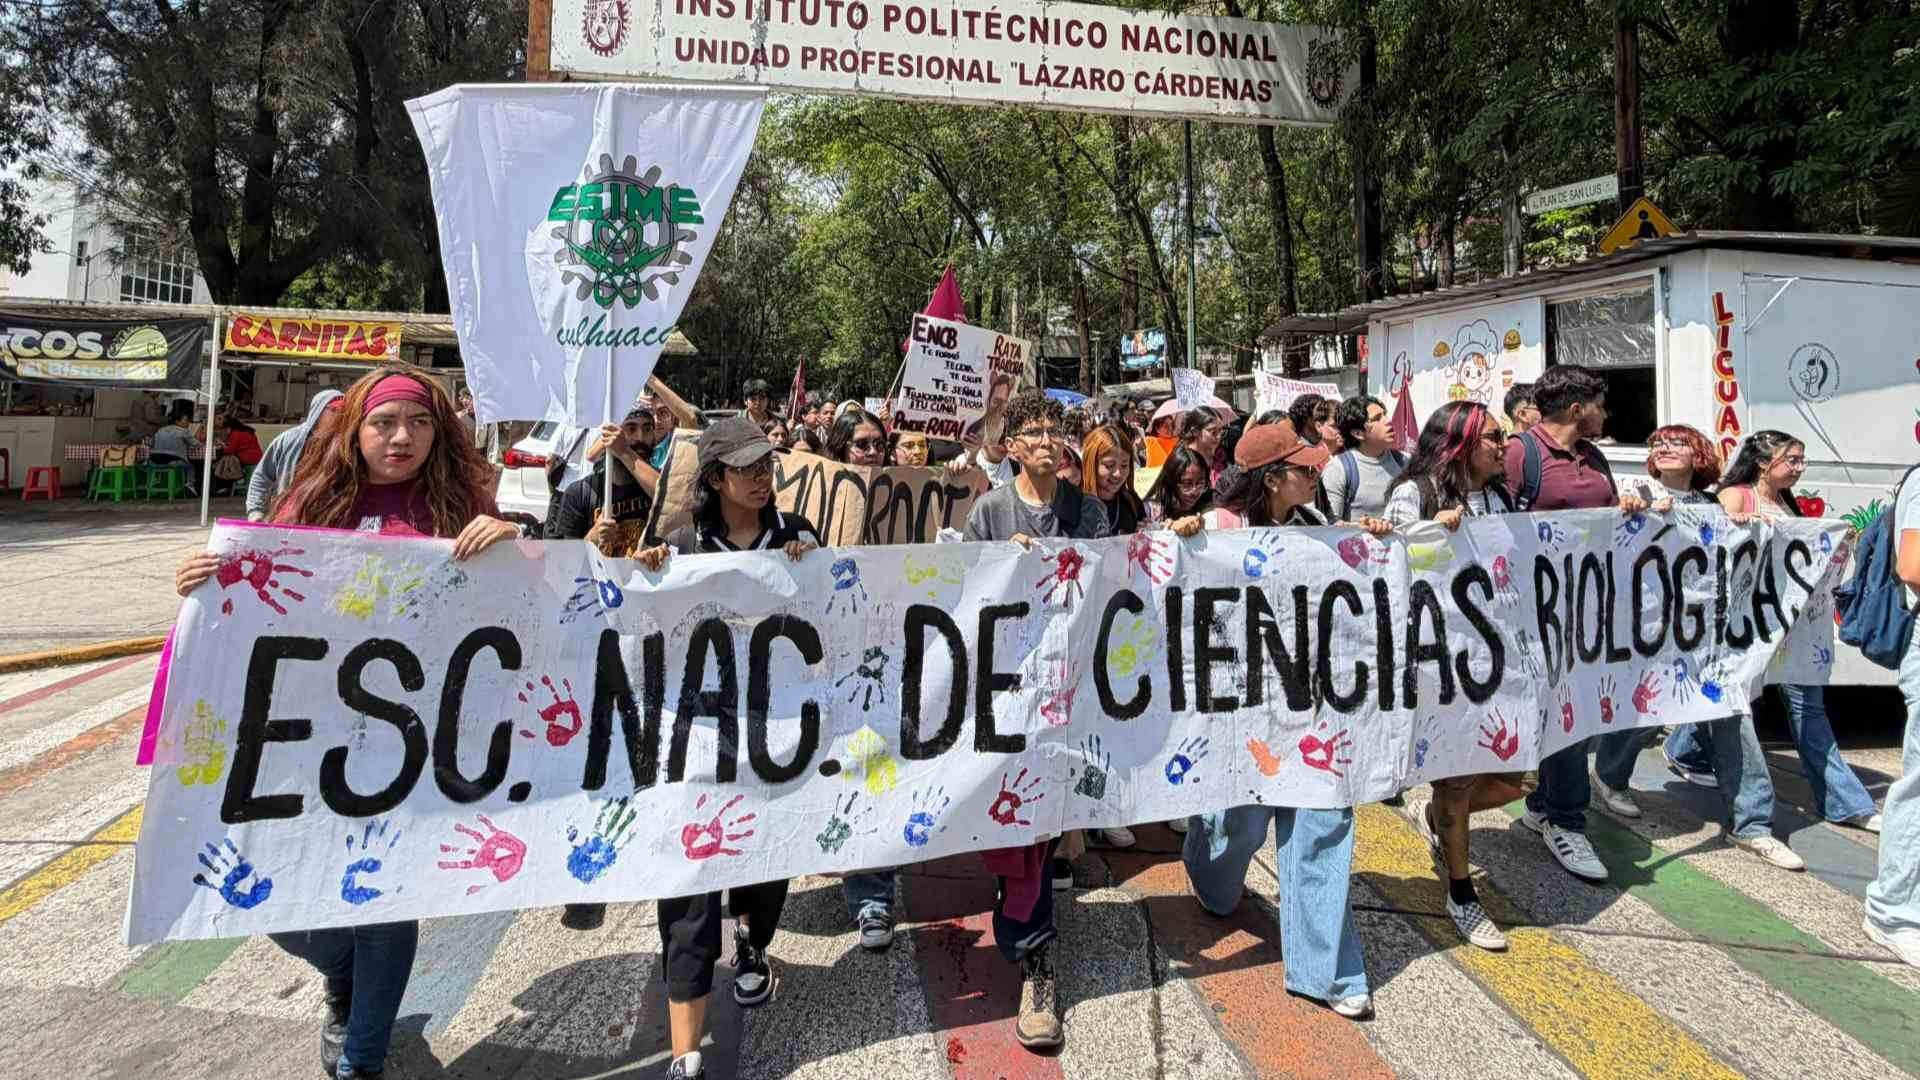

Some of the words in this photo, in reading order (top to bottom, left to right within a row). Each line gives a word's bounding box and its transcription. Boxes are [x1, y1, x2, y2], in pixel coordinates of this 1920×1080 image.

[675, 0, 868, 31] INSTITUTO
[883, 3, 1107, 49] POLITÉCNICO
[1121, 24, 1277, 62] NACIONAL
[675, 37, 789, 68] UNIDAD
[801, 46, 1001, 83] PROFESIONAL
[1011, 54, 1124, 93] "LÁZARO
[1134, 66, 1279, 103] CÁRDENAS"
[548, 183, 704, 224] ESIME
[1569, 186, 1585, 200] SAN
[1586, 182, 1602, 198] LUIS
[231, 316, 388, 356] CARNITAS
[912, 317, 958, 350] ENCB
[994, 335, 1022, 359] RATA
[220, 626, 532, 823] ESC.
[582, 614, 841, 791] NAC.
[900, 601, 1030, 760] DE
[1094, 560, 1506, 722] CIENCIAS
[1534, 523, 1814, 689] BIOLÓGICAS
